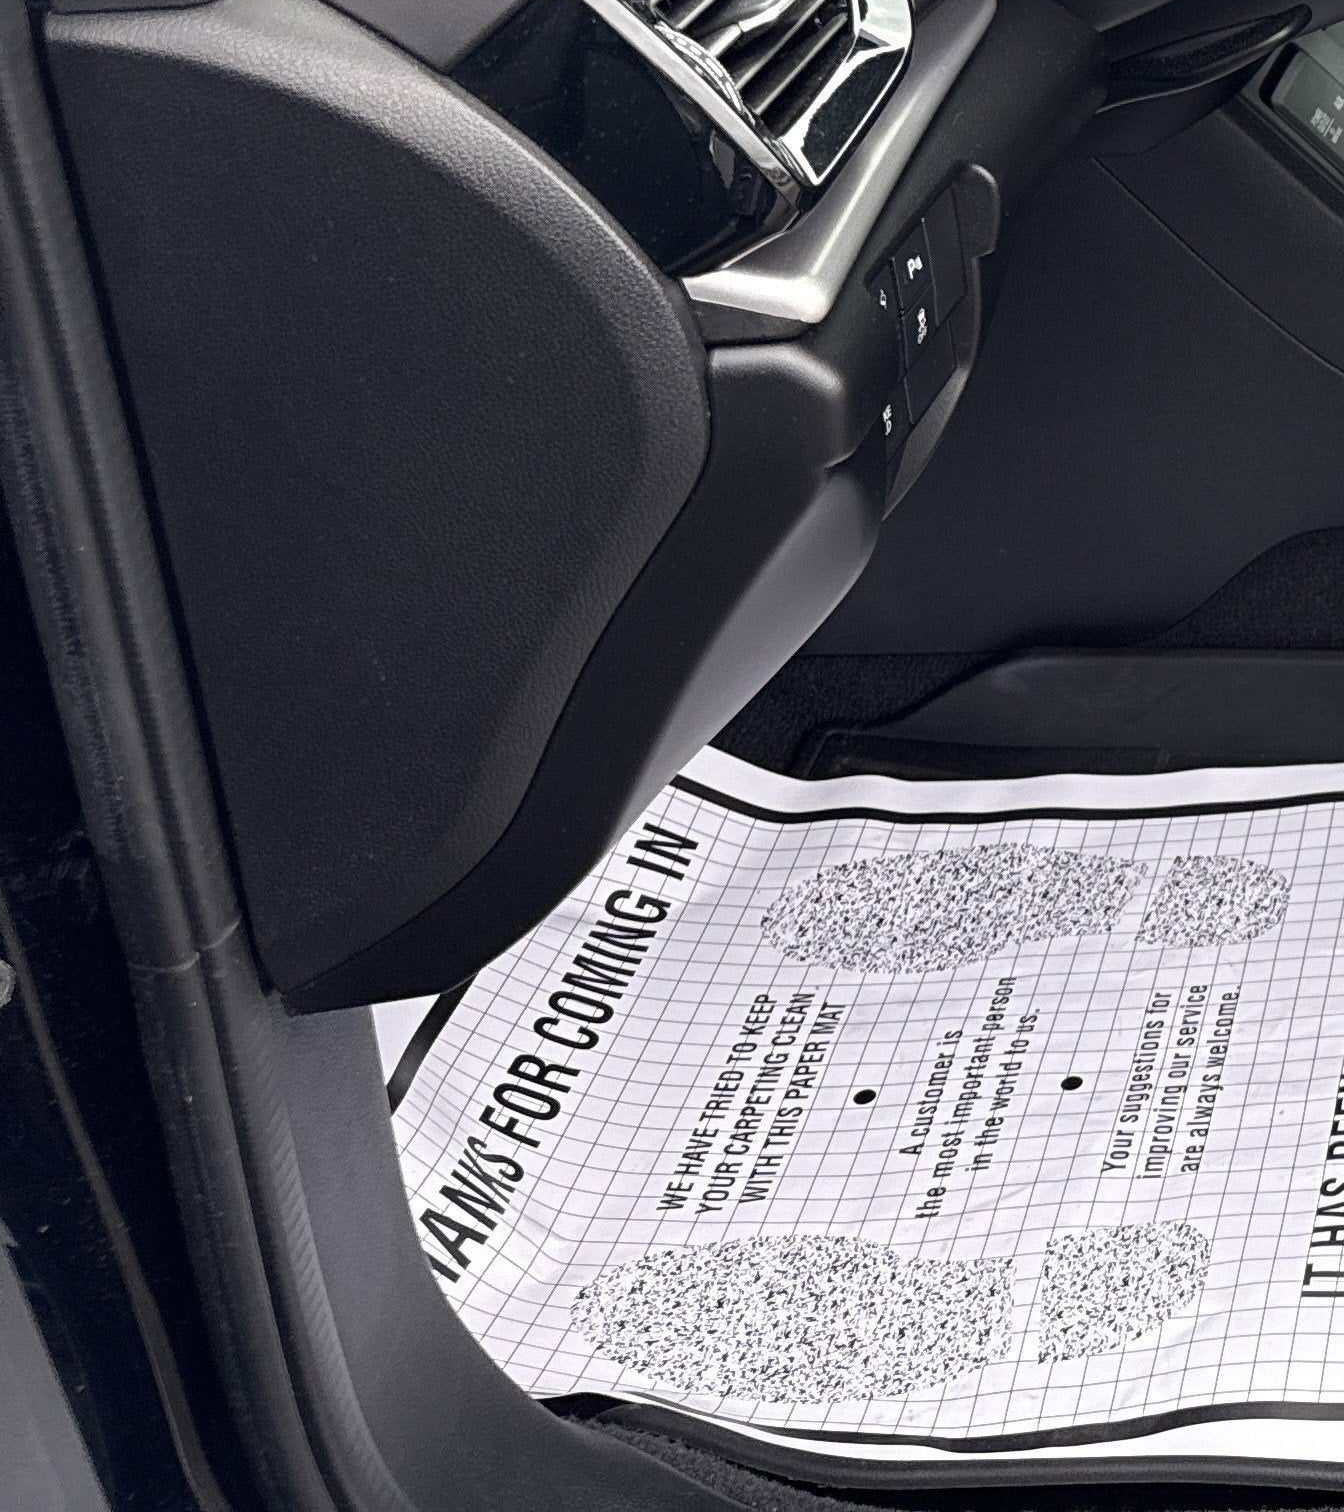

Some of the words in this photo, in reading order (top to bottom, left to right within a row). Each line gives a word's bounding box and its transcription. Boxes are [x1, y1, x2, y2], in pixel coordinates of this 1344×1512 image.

[739, 994, 777, 1035] KEEP
[982, 976, 1017, 1032] person
[1016, 1008, 1040, 1034] us.
[1177, 985, 1208, 1046] service
[1206, 985, 1241, 1068] welcome.
[419, 1135, 525, 1284] ANKS
[479, 1054, 581, 1148] FOR
[533, 890, 671, 1050] COMING
[625, 823, 700, 881] IN
[726, 1042, 757, 1064] TO
[937, 1030, 963, 1046] is
[1004, 1039, 1029, 1054] to
[944, 1035, 996, 1125] important
[990, 1061, 1022, 1111] world
[1101, 1130, 1135, 1174] Your
[1120, 1020, 1164, 1123] suggestions
[1145, 992, 1172, 1014] for
[1168, 1053, 1191, 1079] our
[699, 1071, 744, 1121] TRIED
[739, 1155, 783, 1203] WITH
[764, 1107, 803, 1149] THIS
[784, 1040, 830, 1099] PAPER
[810, 1002, 846, 1035] MAT
[911, 1052, 956, 1136] customer
[1187, 1074, 1224, 1138] always
[674, 1128, 719, 1175] HAVE
[695, 1162, 743, 1214] YOUR
[724, 1052, 789, 1155] CARPETING
[899, 1142, 925, 1155] A
[933, 1130, 965, 1178] most
[974, 1117, 1004, 1147] the
[1137, 1085, 1188, 1179] improving
[965, 1152, 993, 1172] in
[1181, 1145, 1205, 1173] are
[656, 1182, 694, 1210] WE
[915, 1186, 946, 1218] the
